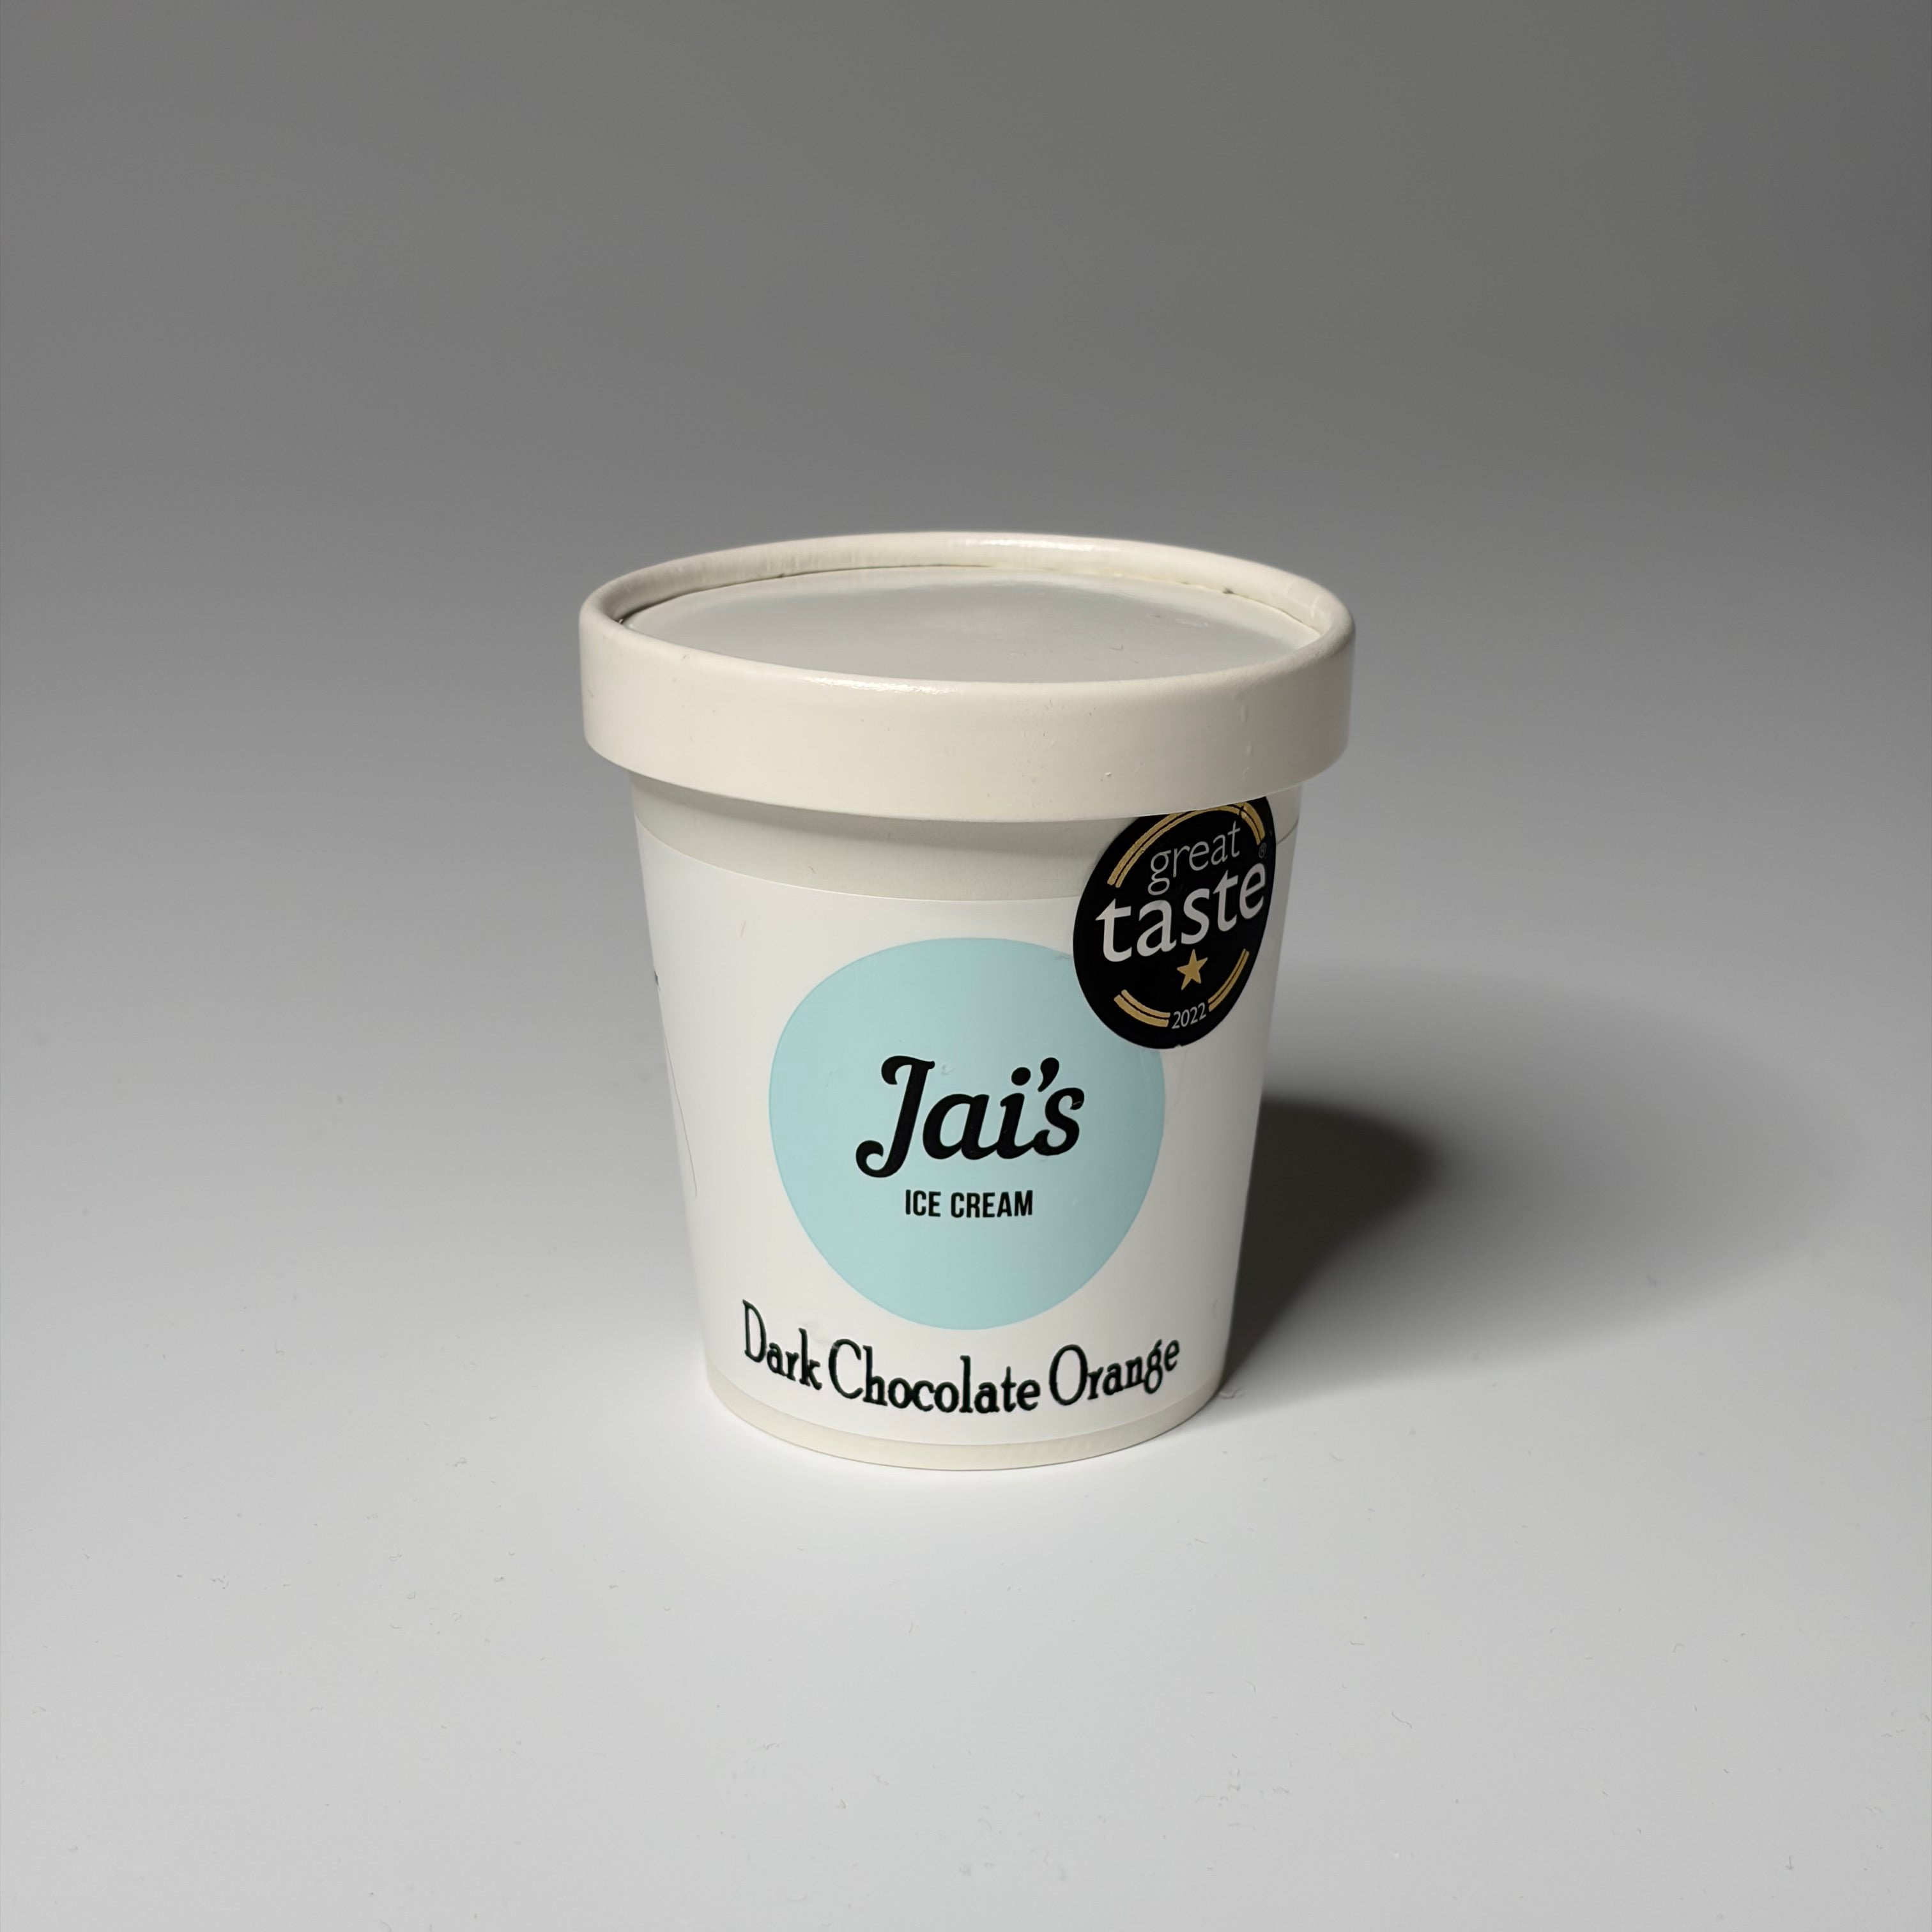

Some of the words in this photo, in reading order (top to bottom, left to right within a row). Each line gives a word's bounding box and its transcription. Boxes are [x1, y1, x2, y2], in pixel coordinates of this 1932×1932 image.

[1147, 820, 1241, 896] great
[1095, 862, 1266, 962] taste
[1171, 1002, 1207, 1029] 2022
[855, 1055, 1085, 1178] Jai's
[905, 1189, 941, 1217] ICE
[951, 1190, 1033, 1218] CREAM
[742, 1299, 822, 1390] Dark
[828, 1338, 1041, 1414] Chocolate
[1048, 1338, 1180, 1406] Orange
